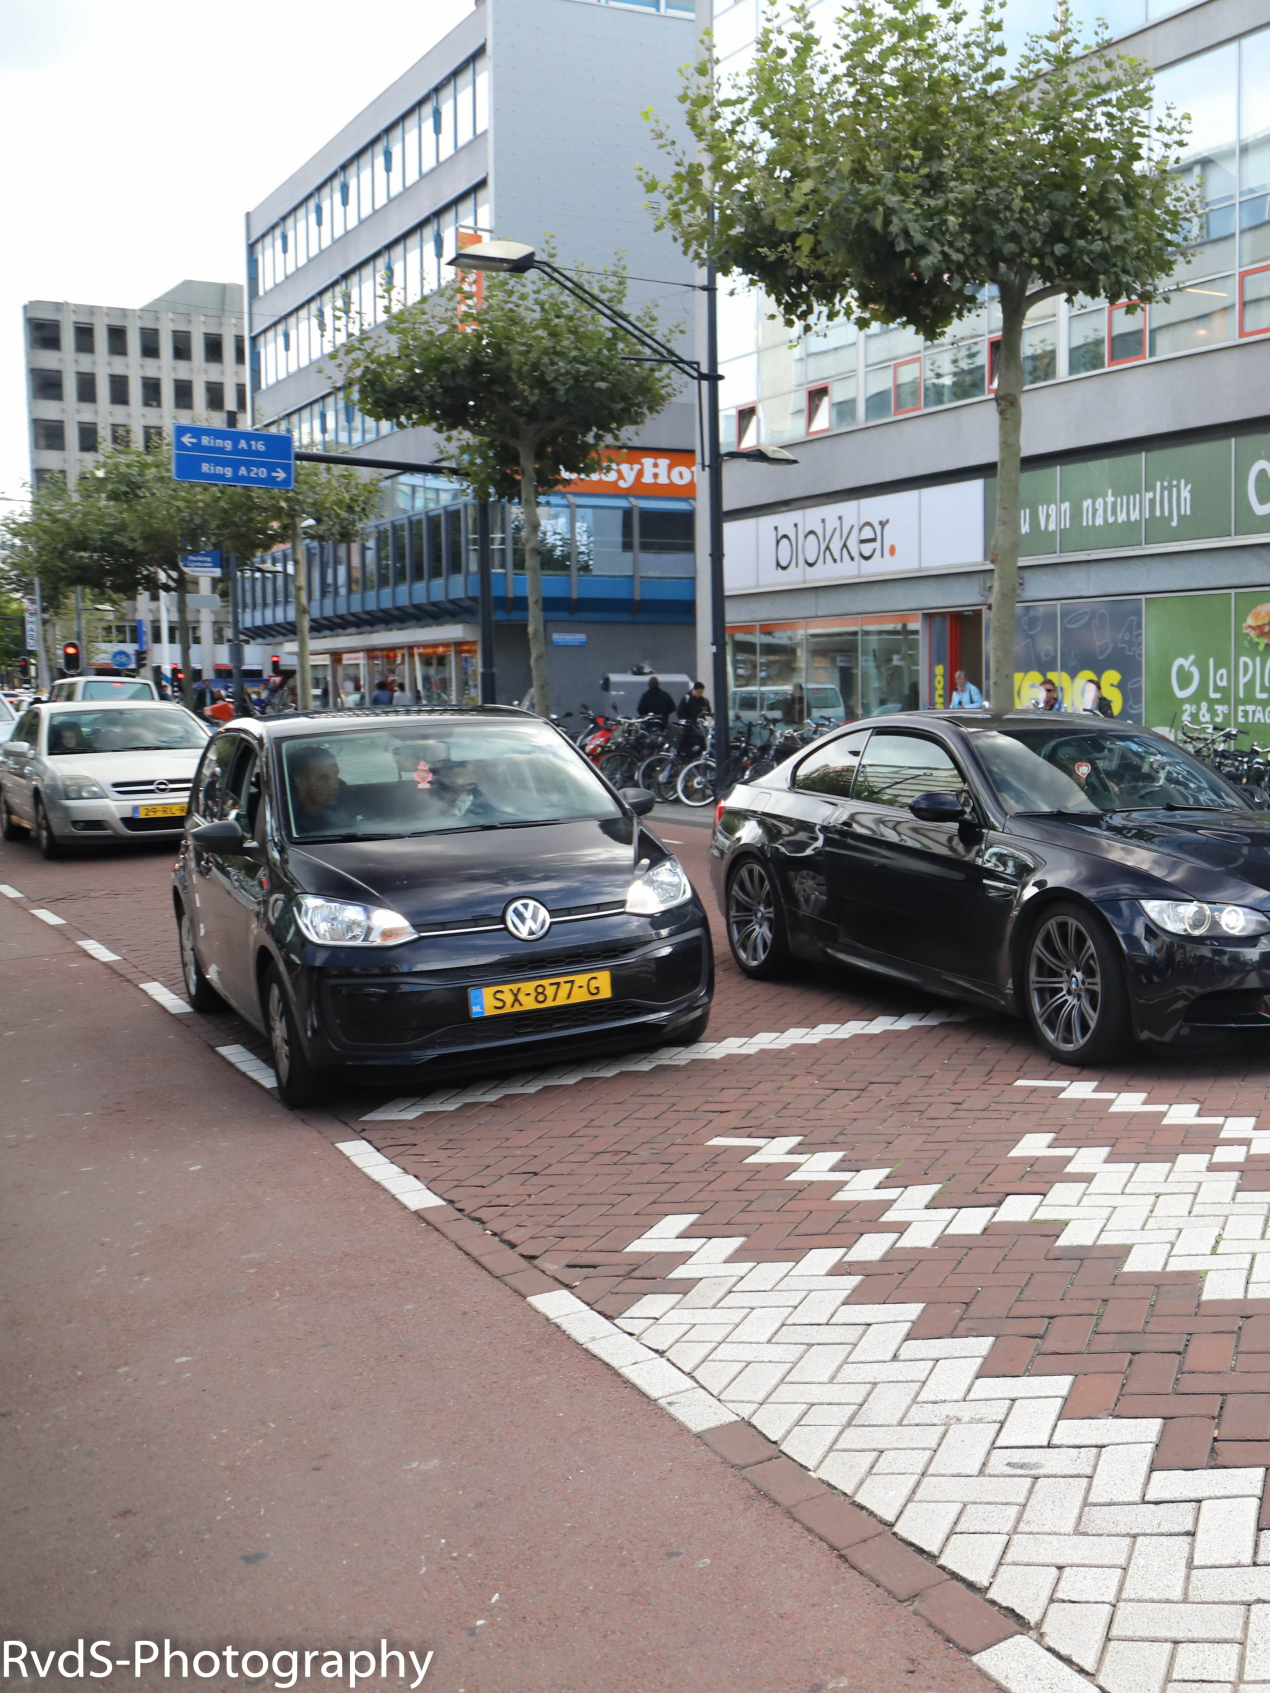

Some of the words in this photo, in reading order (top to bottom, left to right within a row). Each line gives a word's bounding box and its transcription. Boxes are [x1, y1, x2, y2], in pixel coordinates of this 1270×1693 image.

[201, 435, 232, 450] Ring
[238, 440, 266, 452] A16
[201, 462, 232, 478] Ring
[238, 467, 268, 478] A20
[1038, 501, 1070, 532] van
[1082, 479, 1192, 527] natuurlijk
[1199, 701, 1211, 722] &
[493, 976, 600, 1010] SX-877-G
[472, 1005, 484, 1013] NL
